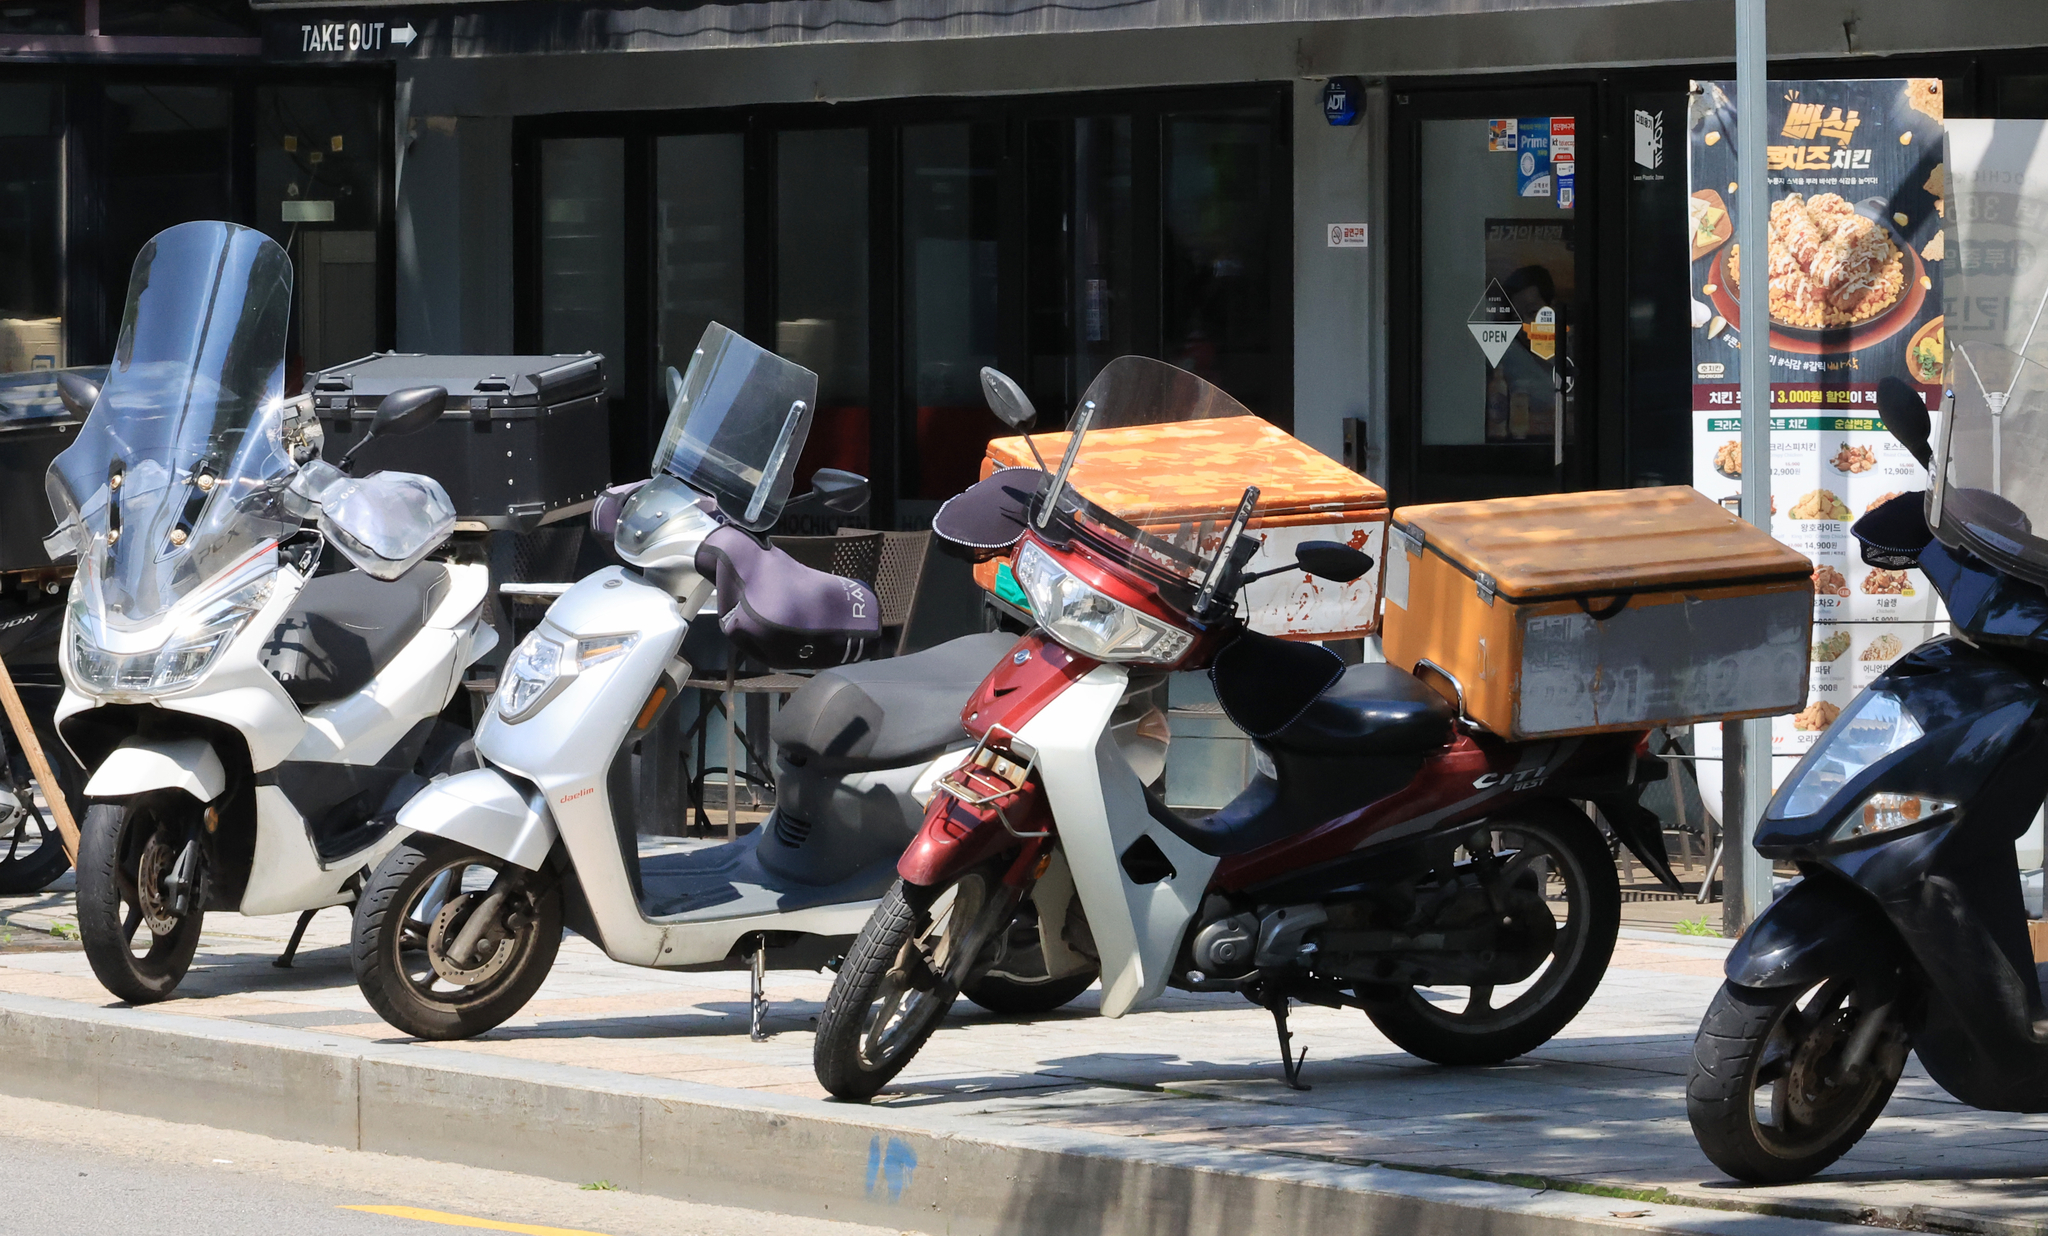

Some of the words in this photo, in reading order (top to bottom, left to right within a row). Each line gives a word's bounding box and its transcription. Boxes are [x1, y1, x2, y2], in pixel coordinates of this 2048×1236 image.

[301, 24, 345, 52] TAKE
[349, 23, 385, 51] OUT
[1327, 94, 1346, 110] ADT
[1780, 102, 1861, 149] 빠삭
[1520, 134, 1549, 149] Prime
[1654, 110, 1664, 169] ZONE
[1344, 227, 1365, 237] 금연구역
[1482, 330, 1508, 343] OPEN
[1777, 357, 1801, 371] #식감
[1802, 360, 1826, 372] #갈릭
[1709, 391, 1733, 404] 치킨
[1777, 390, 1823, 404] 3,000원
[1826, 390, 1862, 403] 할인이
[1788, 419, 1808, 429] 치킨
[1834, 419, 1873, 430] 순살변경
[1884, 467, 1915, 476] 12,900원
[1801, 523, 1842, 533] 왕호라이드
[1804, 541, 1838, 550] 14,900원
[0, 613, 38, 630] ION
[1815, 665, 1831, 675] 파닭
[1472, 765, 1547, 790] CITI
[560, 787, 595, 804] daelim
